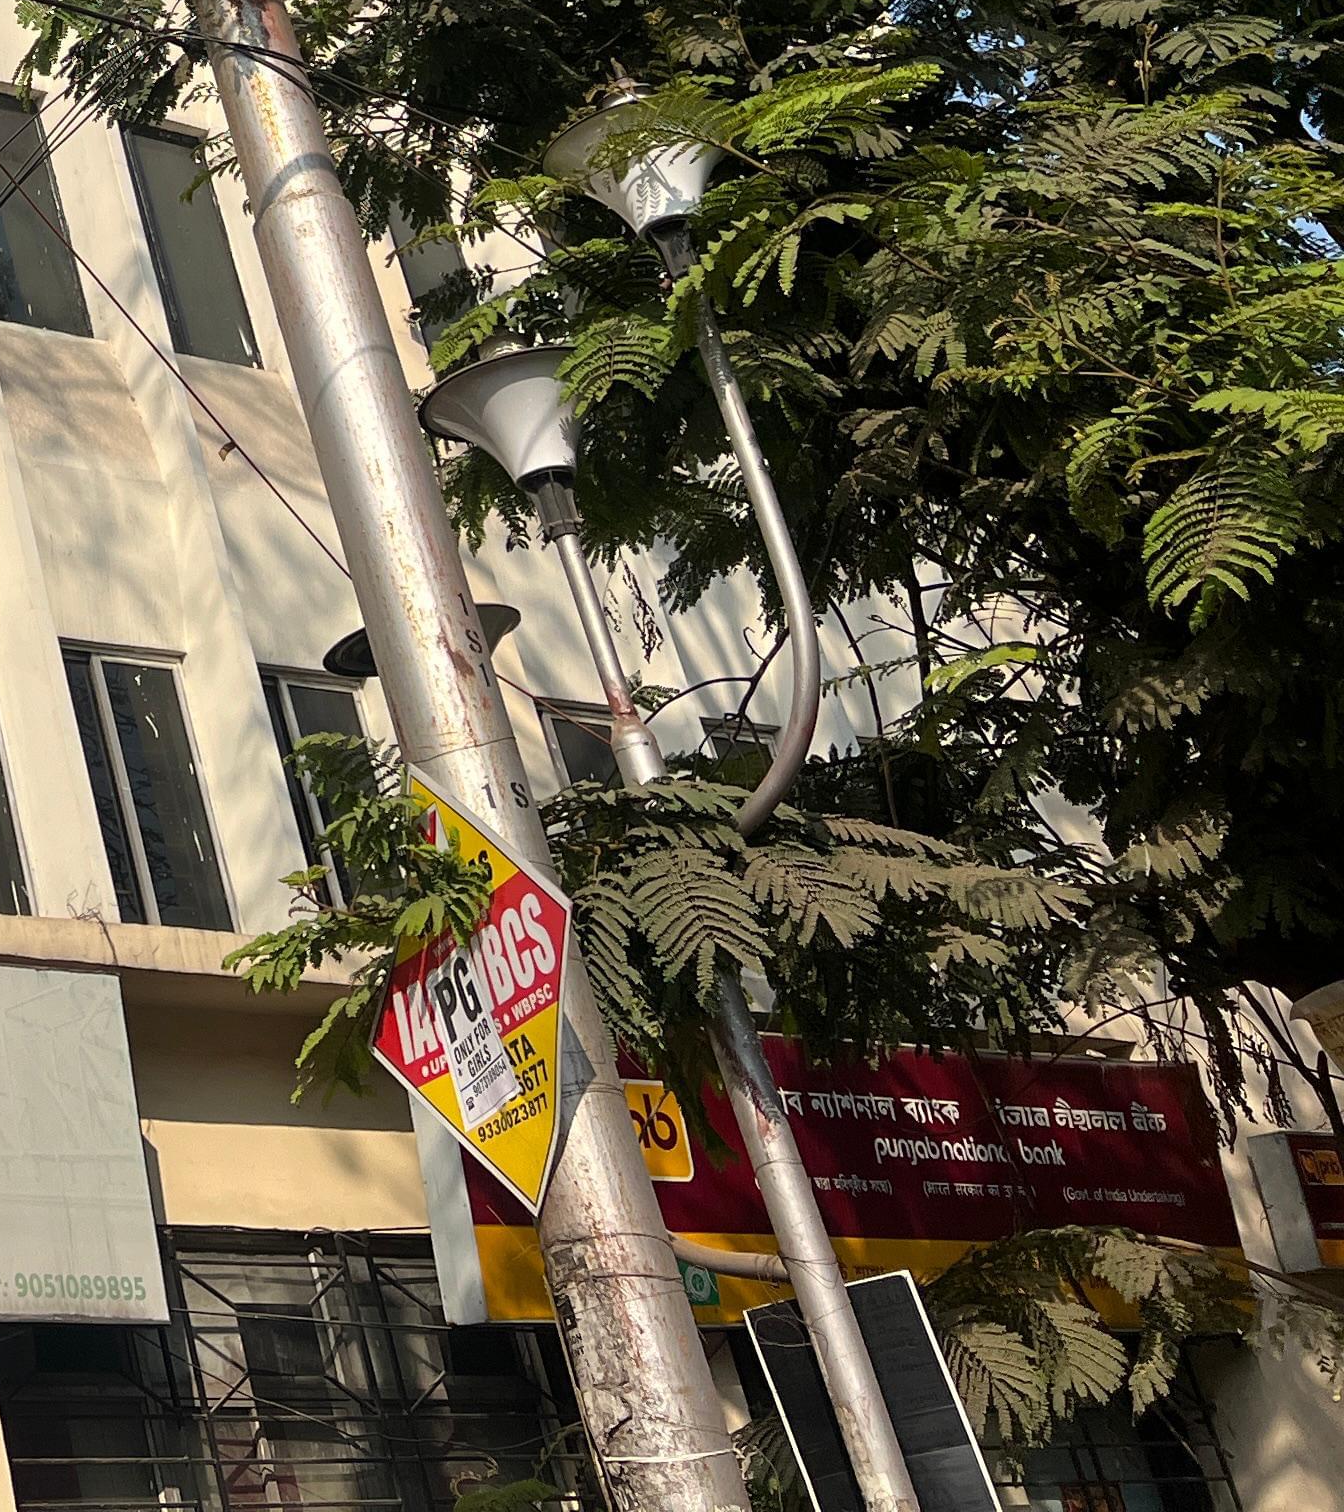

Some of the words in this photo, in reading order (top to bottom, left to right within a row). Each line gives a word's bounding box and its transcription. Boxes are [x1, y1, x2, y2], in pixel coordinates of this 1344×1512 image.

[433, 956, 483, 1045] PG
[510, 983, 554, 1022] WBPSC
[453, 1032, 475, 1065] ONLY
[473, 1017, 492, 1045] FOR
[467, 1043, 492, 1078] GIRLS
[477, 1092, 549, 1143] 9330023877
[900, 1096, 961, 1126] ব্যাংক
[873, 1136, 941, 1166] punjab
[1017, 1137, 1067, 1167] bank
[14, 1272, 147, 1301] 9051089895
